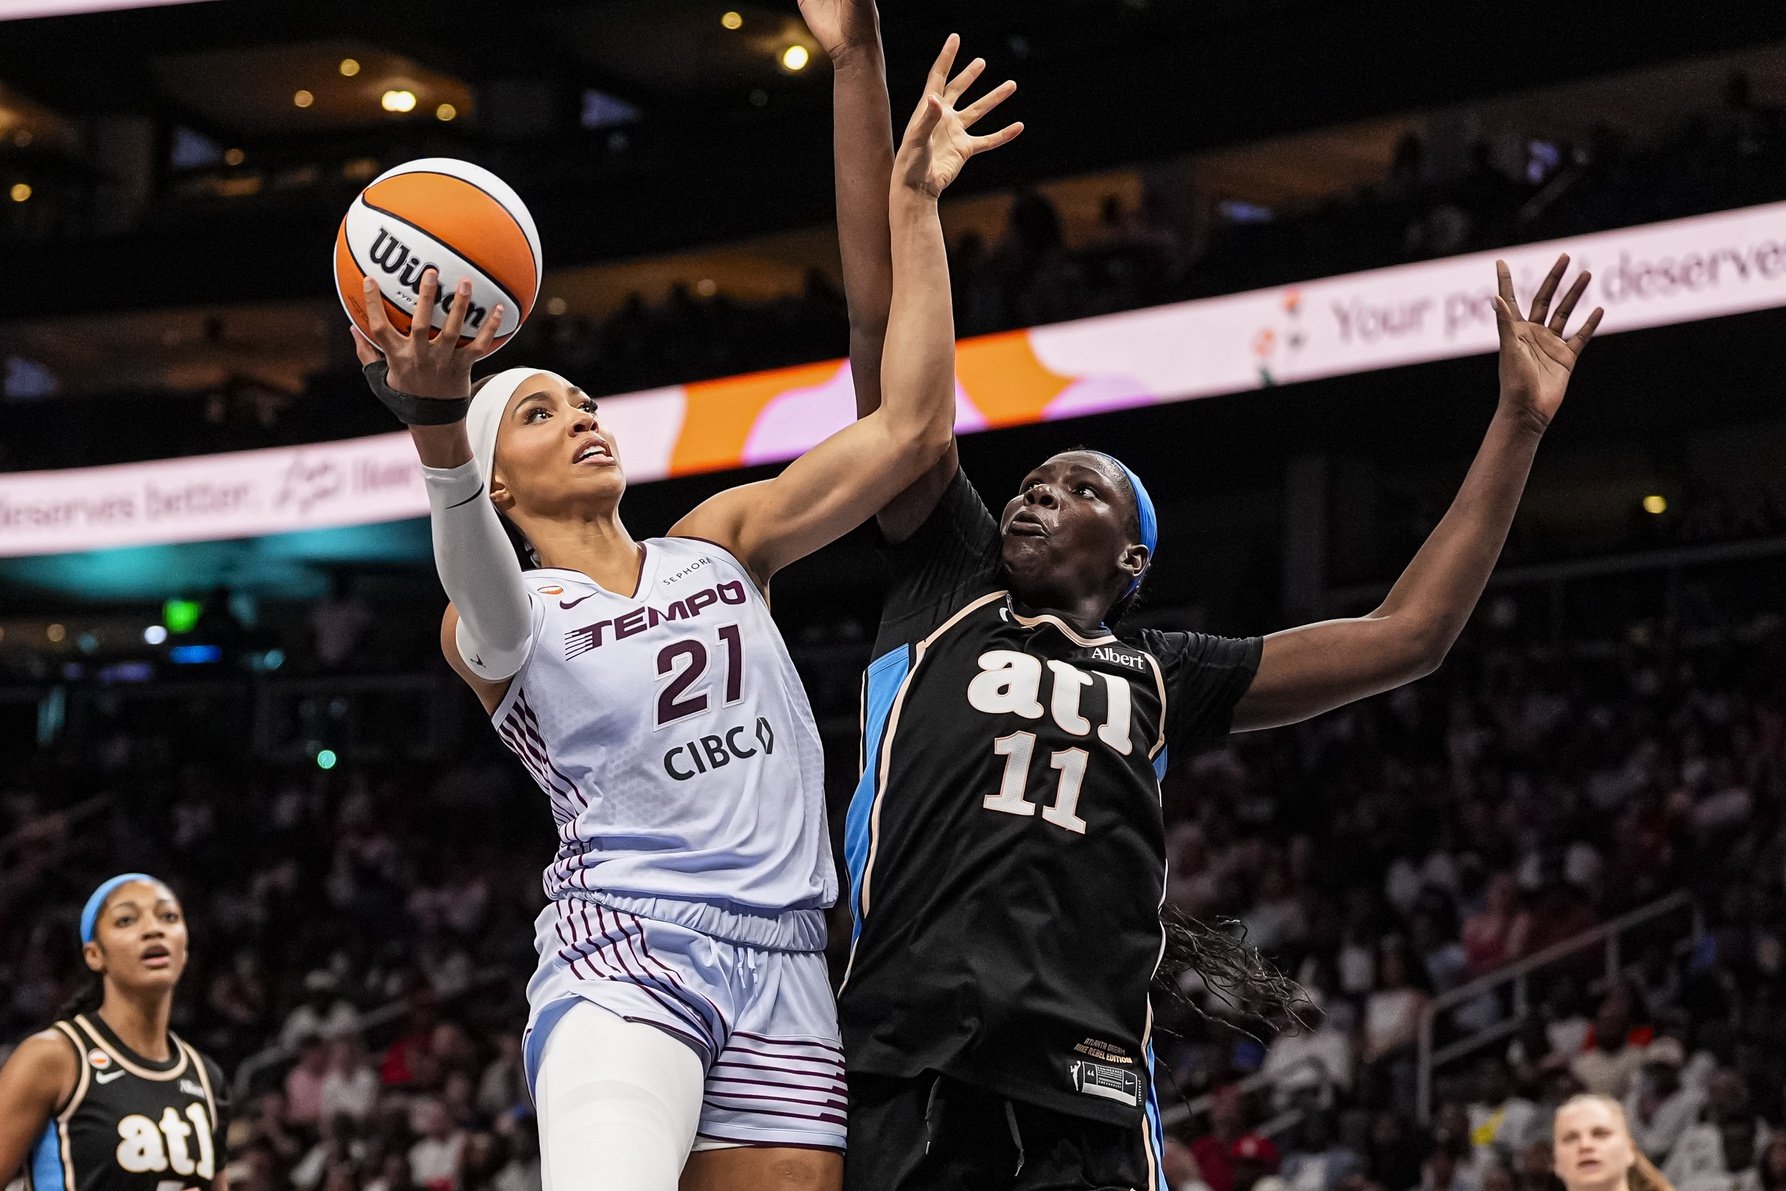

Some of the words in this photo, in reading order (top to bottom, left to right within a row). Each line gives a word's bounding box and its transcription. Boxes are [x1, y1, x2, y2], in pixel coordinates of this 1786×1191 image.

[1330, 293, 1433, 344] Your
[565, 580, 747, 660] TEMPO
[1091, 647, 1144, 670] Albert
[654, 622, 746, 732] 21
[967, 650, 1132, 756] atl
[664, 726, 757, 781] CIBC
[983, 730, 1089, 834] 11
[116, 1102, 215, 1180] atl
